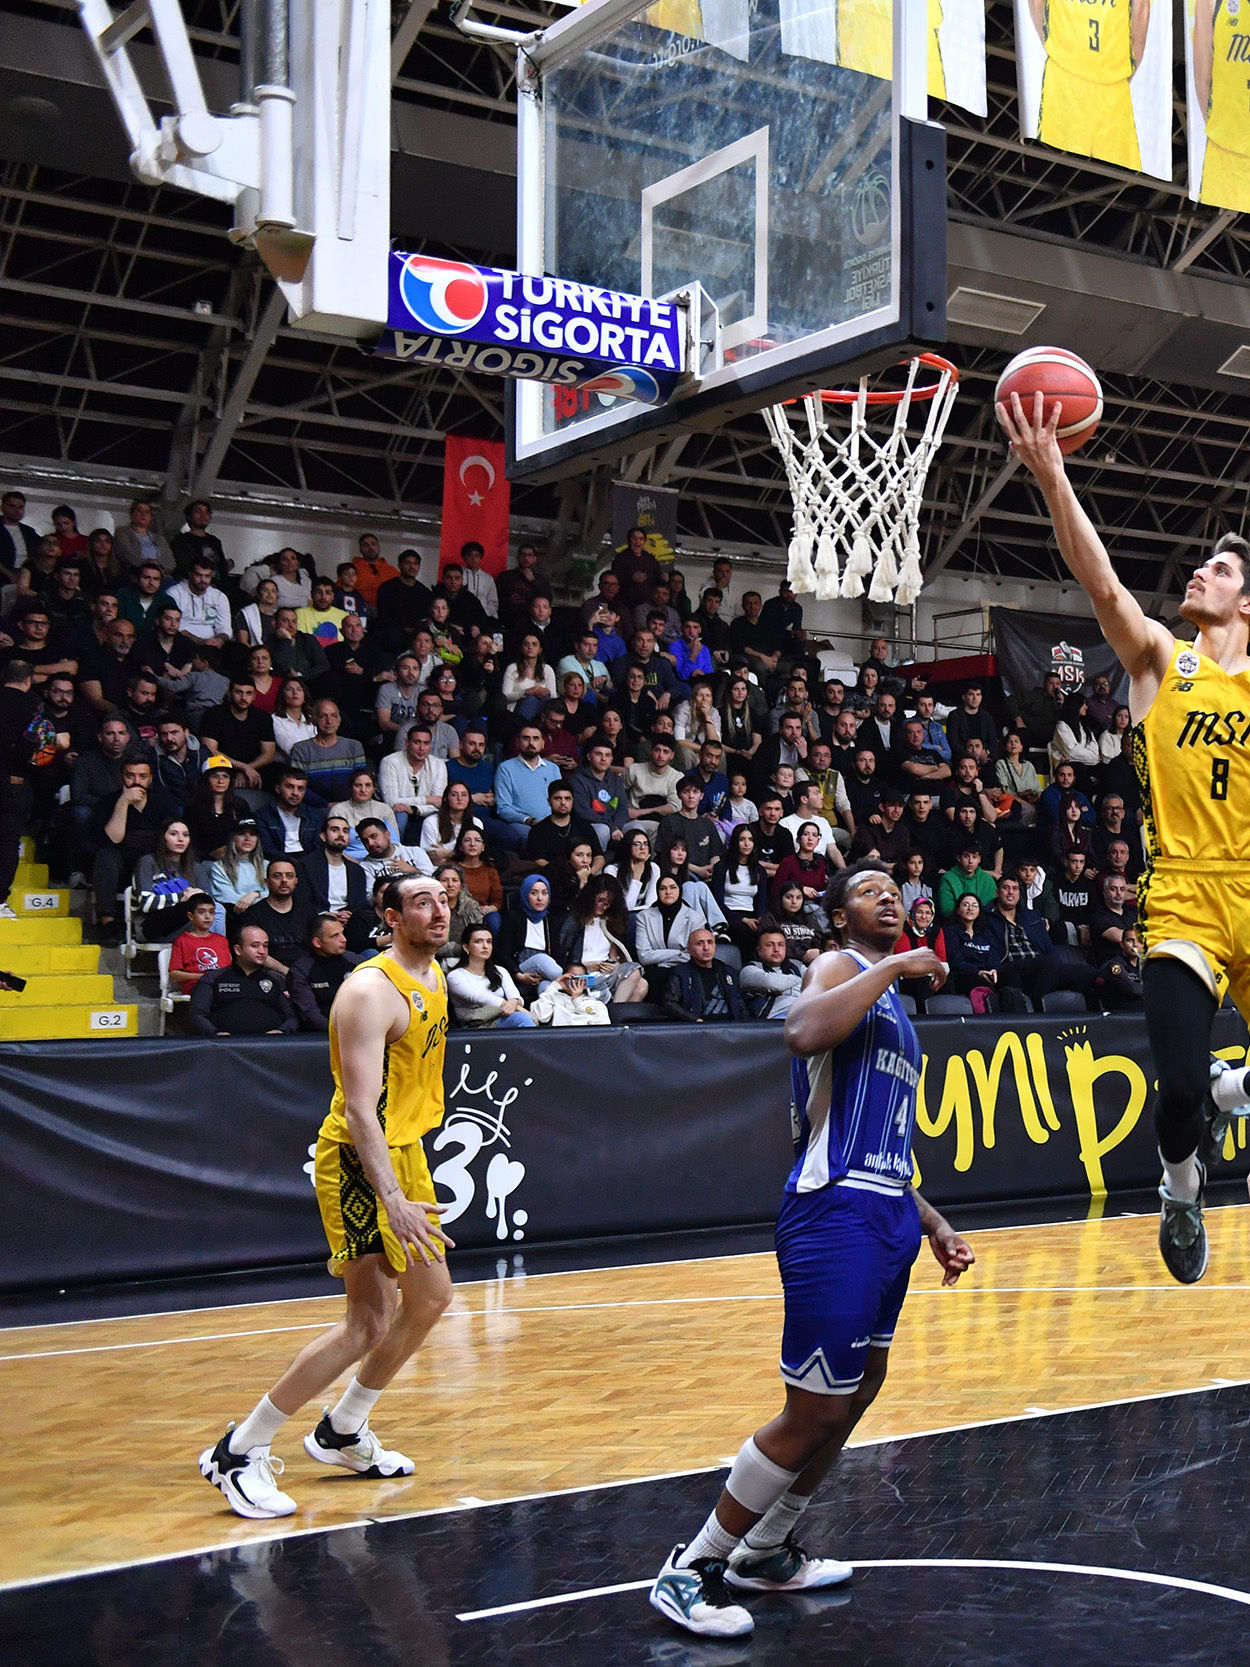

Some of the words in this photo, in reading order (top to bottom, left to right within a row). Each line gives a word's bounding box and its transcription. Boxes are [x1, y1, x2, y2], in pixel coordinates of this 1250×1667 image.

[1089, 19, 1100, 52] 3
[493, 304, 676, 368] SİGORTA
[394, 331, 585, 388] SİGORTA
[1211, 758, 1229, 800] 8
[31, 896, 54, 908] G.4
[98, 1014, 121, 1027] G.2
[894, 1094, 909, 1138] 4
